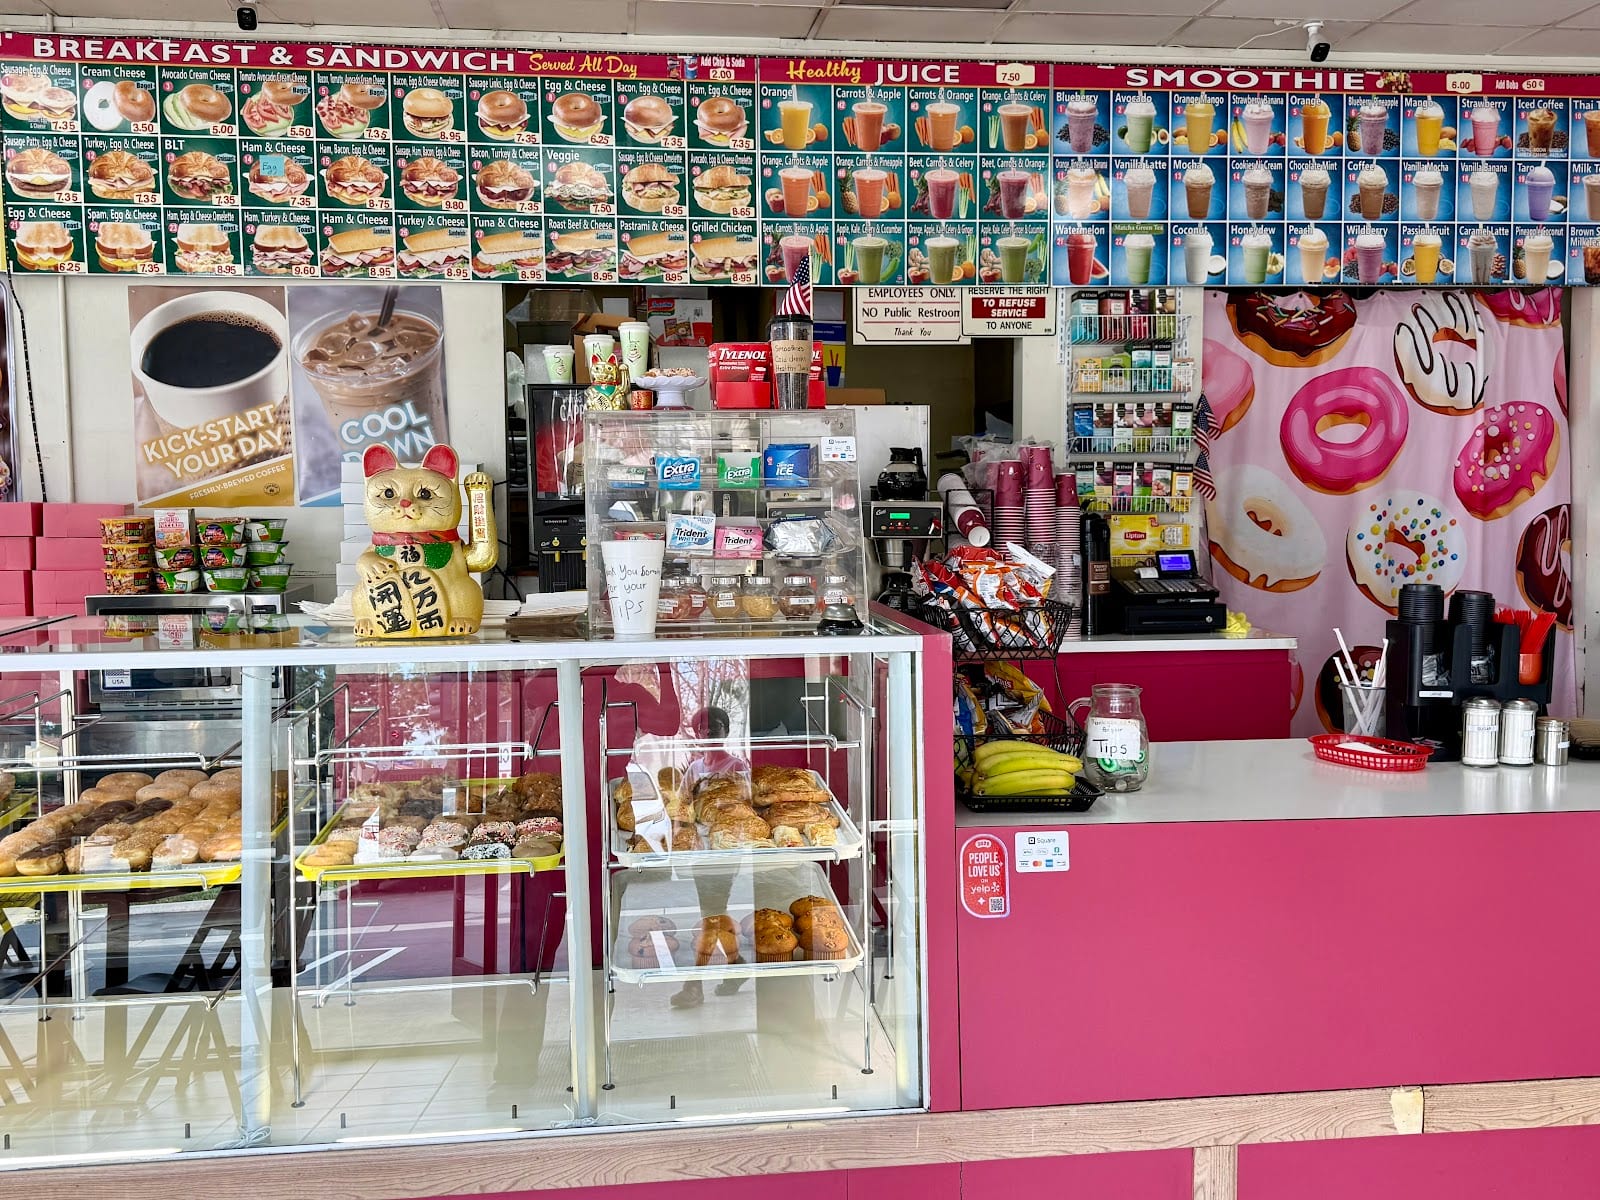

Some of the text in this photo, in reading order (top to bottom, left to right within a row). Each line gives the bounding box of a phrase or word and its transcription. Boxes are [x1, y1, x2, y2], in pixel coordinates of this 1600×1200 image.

[33, 38, 515, 72] BREAKFAST & SANDWICH
[701, 56, 711, 66] Add
[731, 57, 745, 67] Soda
[50, 66, 71, 75] Cheese
[82, 66, 146, 78] Cream Cheese
[529, 53, 637, 83] Served All Day
[161, 68, 230, 80] Avocado Cream Cheese
[712, 70, 731, 78] 2.00
[786, 61, 960, 86] Healthy JUICE
[1002, 72, 1020, 81] 7.50
[1126, 69, 1365, 91] SMOOTHIE
[1496, 80, 1518, 89] Add Boba
[545, 80, 606, 92] Egg & Cheese
[761, 87, 793, 99] Orange
[1056, 92, 1098, 103] Blueberry
[1115, 93, 1152, 103] Avocado
[1290, 96, 1322, 107] Orange
[1462, 99, 1507, 110] Strawberry
[1518, 99, 1564, 109] Iced Coffee
[1573, 100, 1595, 110] Thai
[133, 124, 154, 132] 3.50
[212, 126, 233, 134] 5.00
[366, 130, 387, 139] 7.35
[440, 132, 461, 141] 8.95
[516, 134, 537, 143] 7.35
[84, 138, 154, 151] Turkey, Egg & Cheese
[165, 140, 185, 150] BLT
[591, 135, 610, 145] 6.25
[662, 137, 683, 147] 7.35
[731, 139, 751, 149] 7.35
[242, 142, 305, 153] Ham & Cheese
[547, 150, 579, 162] Veggie
[262, 162, 277, 174] Egg
[1173, 160, 1202, 170] Mocha
[1347, 161, 1374, 171] Coffee
[56, 193, 78, 201] 7.35
[136, 195, 156, 203] 7.35
[215, 196, 235, 204] 7.35
[291, 198, 311, 206] 7.35
[369, 200, 390, 208] 8.75
[445, 202, 464, 210] 9.80
[519, 203, 539, 211] 7.35
[8, 207, 71, 219] Egg & Cheese
[88, 209, 157, 221] Spam, Egg & Cheese
[322, 215, 389, 225] Ham & Cheese
[399, 215, 465, 227] Turkey & Cheese
[473, 217, 539, 228] Tuna & Cheese
[620, 220, 684, 231] Pastrami & Cheese
[692, 222, 752, 232] Grilled Chicken
[1055, 225, 1104, 235] Watermelon
[1172, 225, 1208, 235] Coconut
[1288, 225, 1313, 235] Peach
[1346, 225, 1388, 236] Wildberry
[1231, 225, 1276, 237] Honeydew
[295, 267, 316, 275] 9.60
[868, 288, 956, 298] EMPLOYEES ONLY.
[968, 287, 1050, 295] RESERVE THE RIGHT
[982, 299, 1036, 307] TO REFUSE
[862, 307, 878, 318] NO
[884, 307, 912, 318] Public
[991, 309, 1027, 317] SERVICE
[987, 322, 1032, 330] TO ANYONE
[894, 328, 931, 336] Thank You
[719, 348, 766, 360] TYLENOL
[340, 401, 427, 445] COOL
[143, 403, 275, 462] KICK-START
[166, 426, 284, 479] YOUR DAY
[663, 463, 695, 479] Extra
[725, 469, 751, 480] Extra
[776, 467, 794, 475] ICE
[189, 464, 287, 500] FRESHLY-BREWED COFFEE
[675, 527, 707, 539] Trident
[725, 536, 753, 545] Trident
[400, 546, 420, 563] 福
[620, 565, 637, 580] You
[624, 584, 646, 593] your
[1092, 739, 1127, 757] Tips
[969, 852, 998, 864] PEOPLE
[968, 865, 1000, 877] LOVE US
[971, 885, 990, 894] yelp
